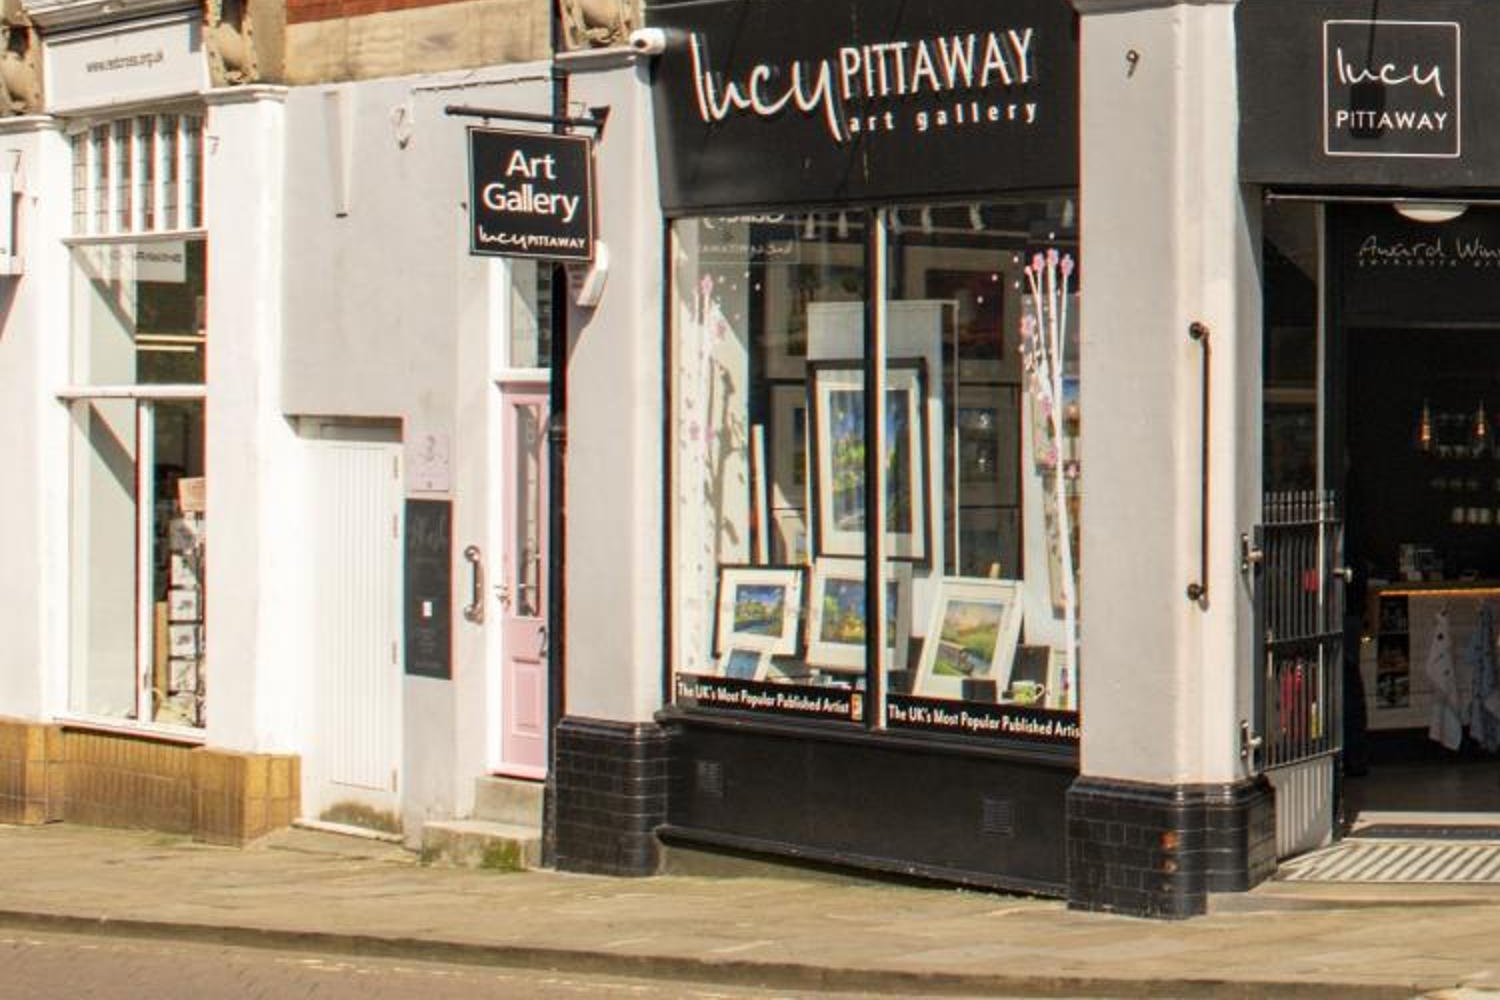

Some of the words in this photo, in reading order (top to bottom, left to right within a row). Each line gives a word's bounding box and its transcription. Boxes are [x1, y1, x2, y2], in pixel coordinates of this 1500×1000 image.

[689, 31, 843, 142] lucy
[839, 27, 1034, 101] PITTAWAY
[1337, 47, 1445, 97] lucy
[849, 112, 894, 133] art
[916, 102, 1038, 132] gallery
[1336, 110, 1448, 130] PITTAWAY
[506, 149, 556, 179] Art
[483, 182, 579, 223] Gallery
[478, 224, 528, 250] lucy
[528, 235, 586, 249] PITTAWAY
[888, 703, 907, 722] The
[908, 705, 931, 724] UK's
[933, 708, 959, 726] Most
[961, 711, 1000, 731] Popular
[1001, 715, 1052, 736] Published
